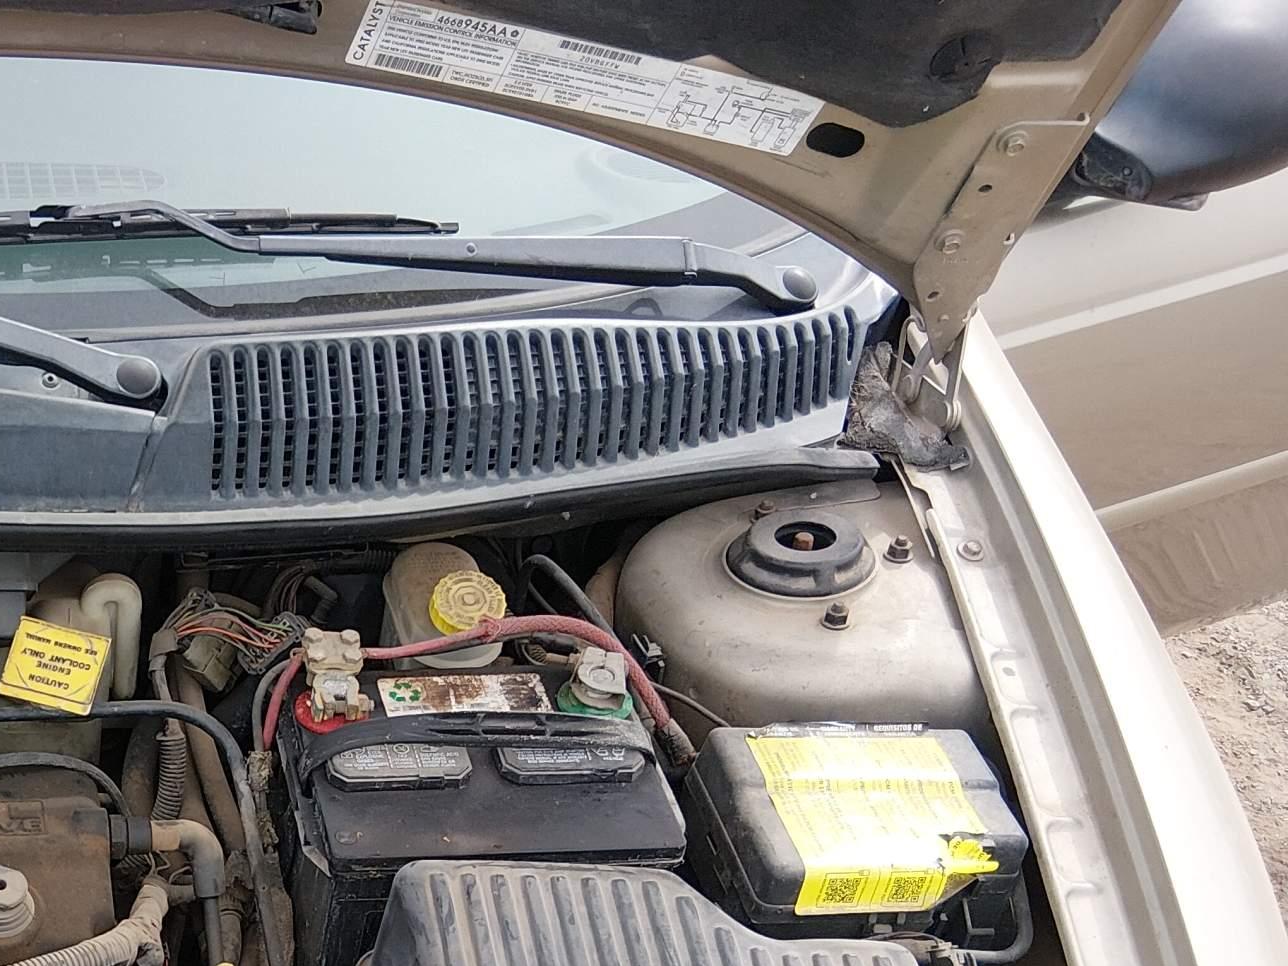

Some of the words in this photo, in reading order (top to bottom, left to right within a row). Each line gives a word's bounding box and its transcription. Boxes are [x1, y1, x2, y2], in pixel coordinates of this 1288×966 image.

[353, 0, 387, 61] CATALYST
[389, 16, 414, 26] VEHICLE
[414, 20, 444, 32] EMISSION
[444, 26, 473, 37] CONTROL
[475, 31, 516, 46] INFORMATION
[437, 16, 507, 37] 4668945AA
[21, 647, 46, 659] ONLY
[36, 661, 71, 675] ENGINE
[49, 655, 91, 670] COOLANT
[28, 674, 69, 690] CAUTION
